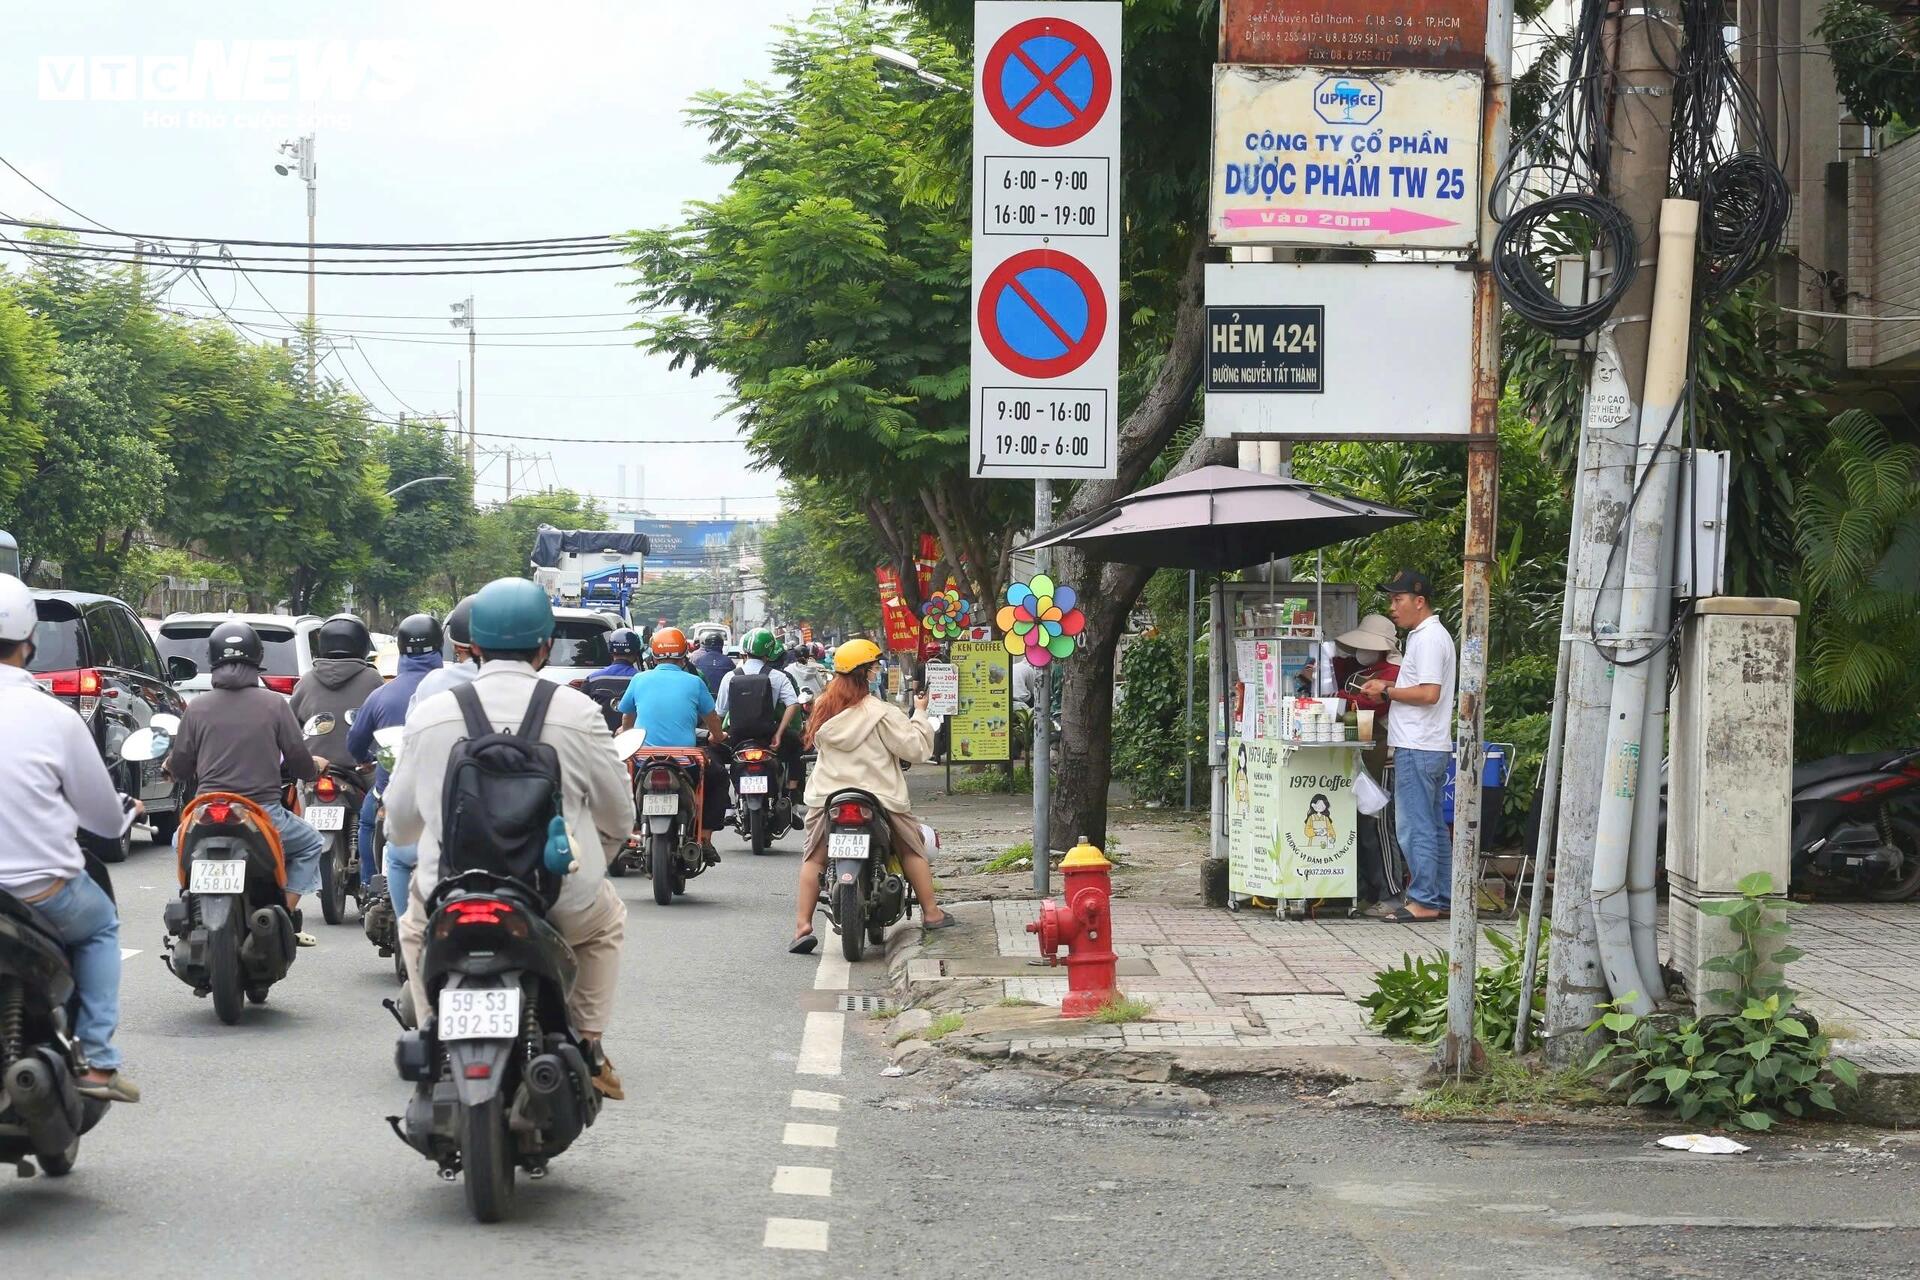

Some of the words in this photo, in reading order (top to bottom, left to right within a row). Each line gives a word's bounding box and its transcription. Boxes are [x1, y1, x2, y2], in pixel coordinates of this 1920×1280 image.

[1320, 93, 1376, 106] UPHACE
[1245, 130, 1308, 151] CÔNG
[1315, 134, 1343, 152] TY
[1351, 128, 1383, 153] CỔ
[1389, 130, 1448, 155] PHẦN
[1003, 170, 1036, 190] 6:00
[1055, 170, 1088, 190] 9:00
[1225, 156, 1296, 201] DƯỢC
[1305, 154, 1380, 197] PHẨM
[1389, 166, 1428, 198] TW
[1436, 168, 1465, 200] 25
[994, 204, 1035, 224] 16:00
[1054, 205, 1095, 225] 19:00
[1260, 211, 1308, 224] Vào
[1318, 214, 1370, 227] 20m
[1212, 313, 1264, 353] HẺM
[1272, 324, 1317, 353] 424
[1212, 363, 1239, 383] ĐƯỜNG
[1241, 361, 1272, 383] NGUYỄN
[1274, 362, 1288, 383] TẤT
[1290, 364, 1317, 383] THÀNH
[1608, 395, 1625, 405] CAO
[998, 400, 1030, 420] 9:00
[1050, 402, 1091, 422] 16:00
[996, 435, 1037, 454] 19:00
[1056, 436, 1088, 456] 6:00
[957, 643, 972, 651] KEN
[975, 643, 1001, 651] COFFEE
[1249, 746, 1261, 764] 1979
[1262, 748, 1277, 768] Coffee
[1290, 775, 1316, 788] 1979
[1319, 775, 1352, 791] Coffee
[835, 835, 863, 846] 67-AA
[831, 847, 866, 856] 260.57
[452, 992, 506, 1012] 59-S3
[444, 1014, 513, 1036] 392.55
